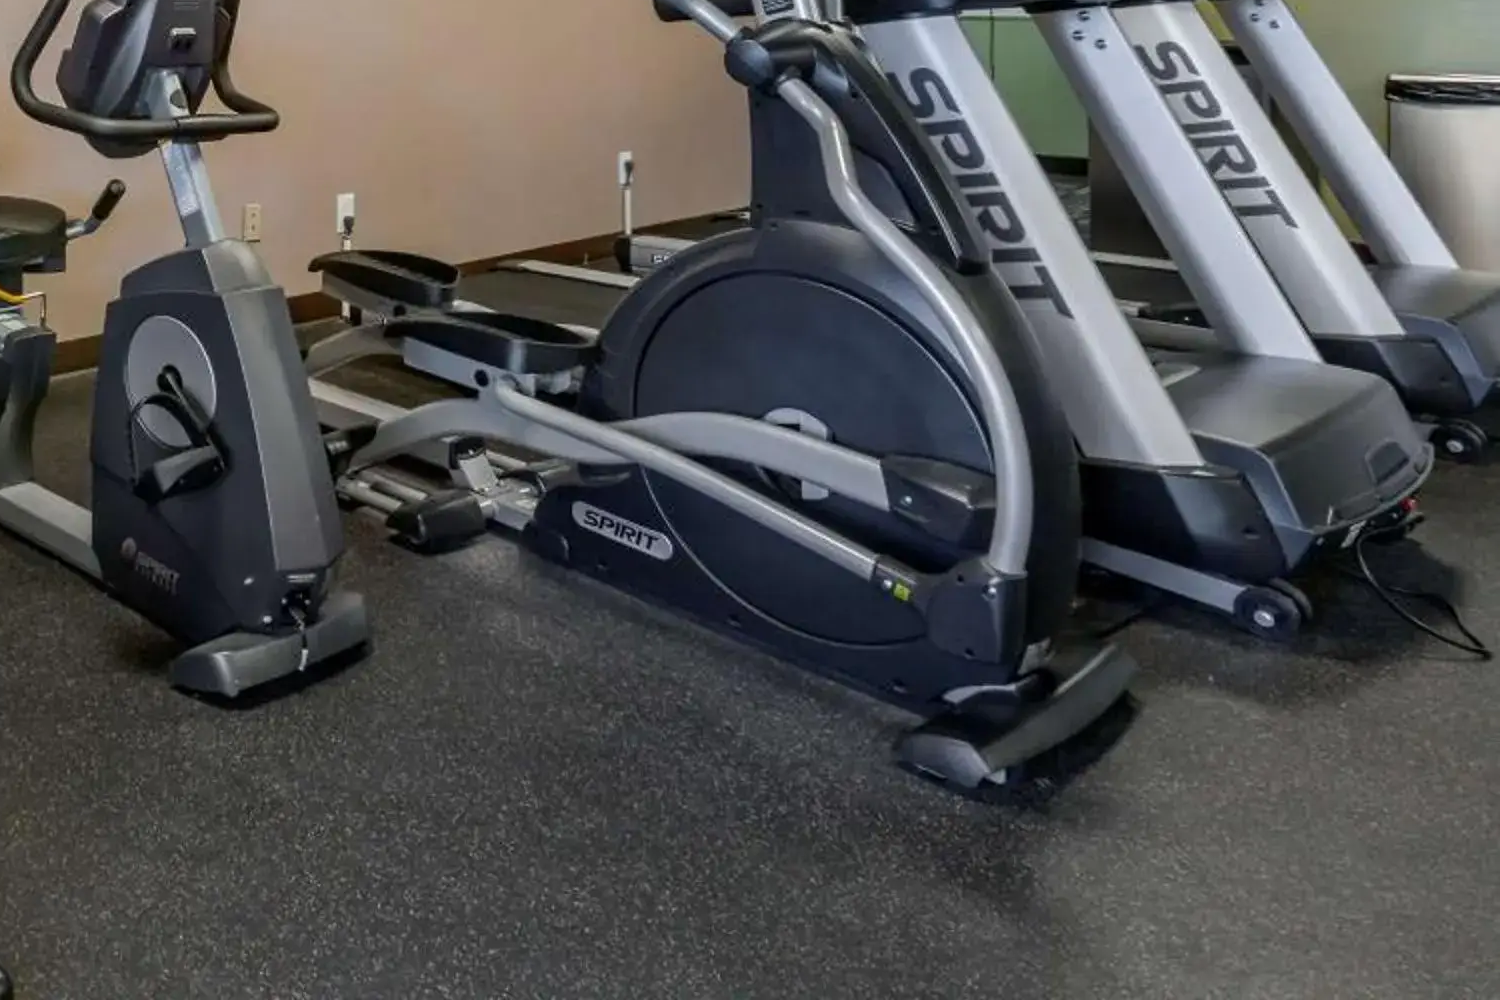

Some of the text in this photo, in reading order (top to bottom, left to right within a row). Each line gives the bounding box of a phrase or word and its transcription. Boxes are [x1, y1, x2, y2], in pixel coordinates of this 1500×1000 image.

[886, 67, 1074, 319] SPIRIT
[1133, 41, 1299, 228] SPIRIT
[583, 510, 661, 550] SPIRIT
